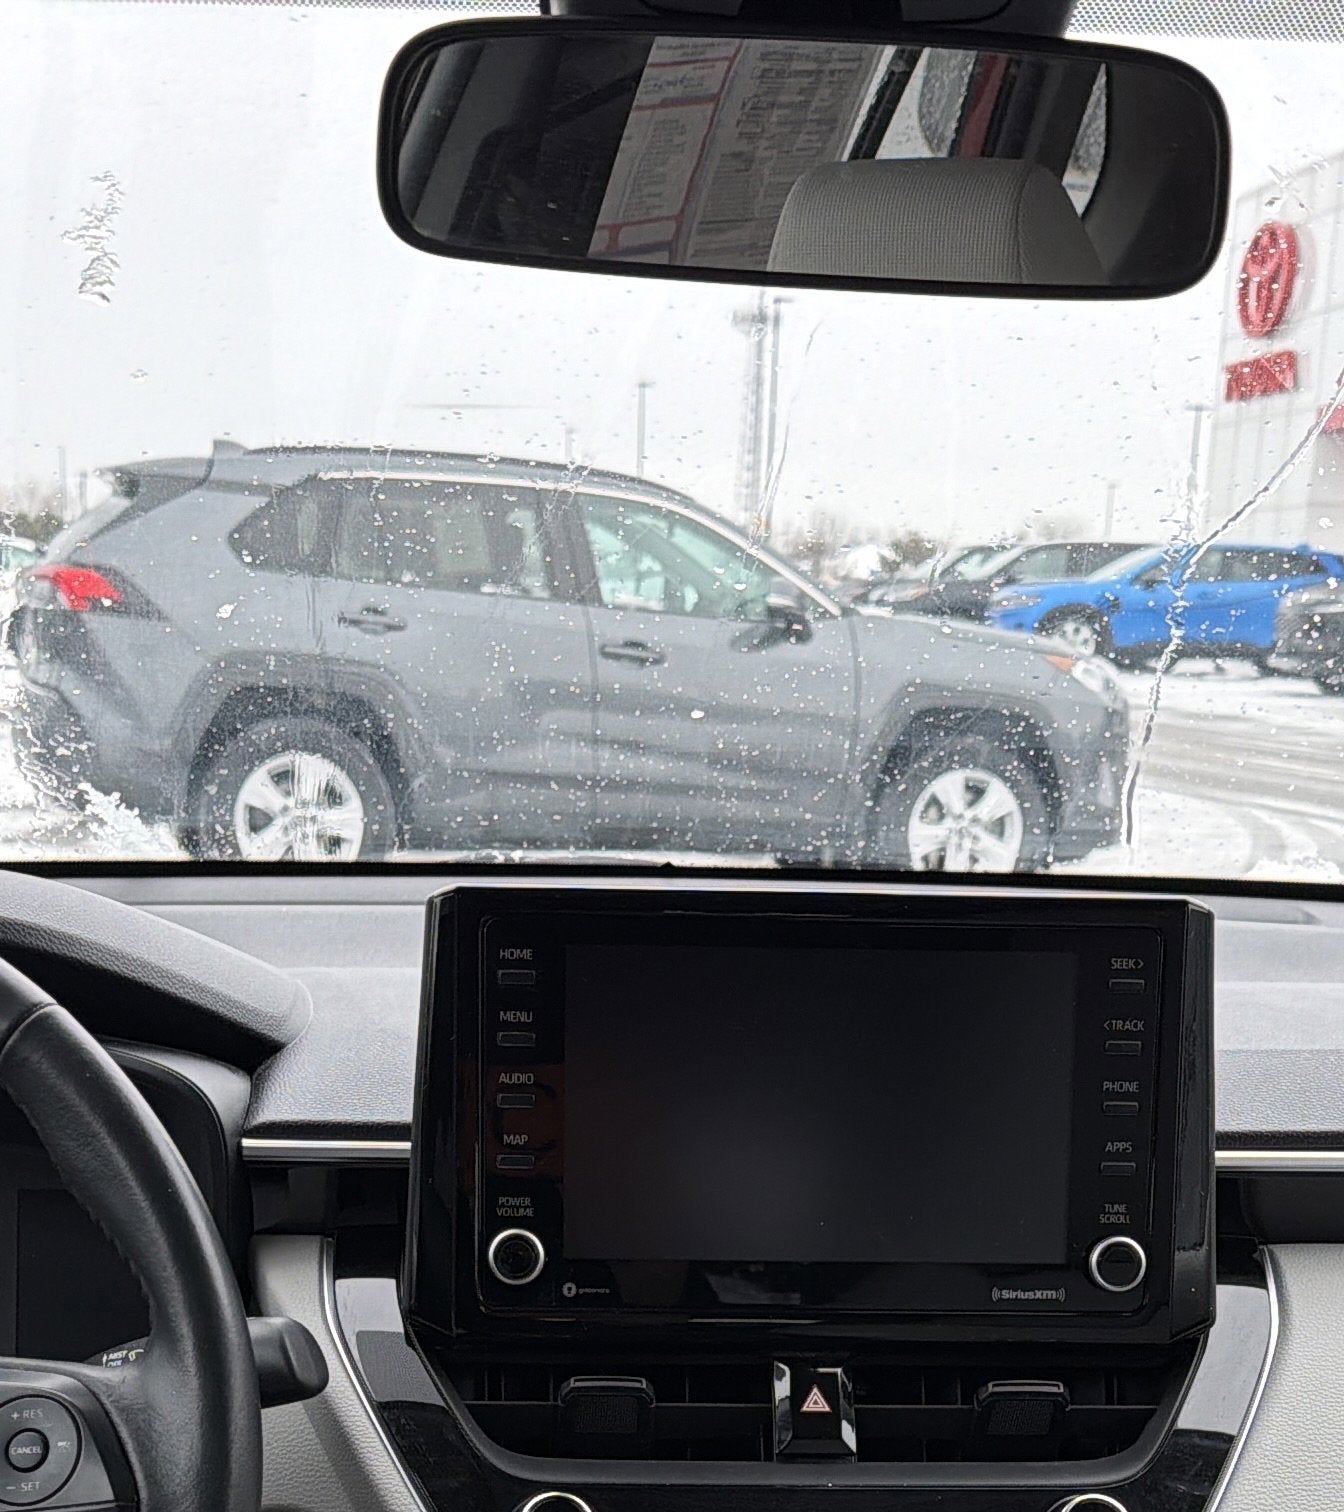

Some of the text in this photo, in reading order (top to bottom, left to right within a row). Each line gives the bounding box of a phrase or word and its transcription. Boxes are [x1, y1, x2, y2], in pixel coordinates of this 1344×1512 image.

[499, 949, 533, 960] HOME
[499, 1011, 533, 1023] MENU
[498, 1073, 534, 1084] AUDIO
[1102, 1081, 1140, 1093] PHONE
[503, 1134, 528, 1145] MAP
[1105, 1142, 1132, 1153] APPS
[498, 1197, 532, 1207] POWER
[496, 1207, 534, 1217] VOLUME
[1104, 1203, 1127, 1213] TUNE
[1099, 1214, 1130, 1224] SCROLL
[23, 1409, 43, 1419] RES
[11, 1446, 42, 1456] CANCEL
[21, 1482, 40, 1491] SET
